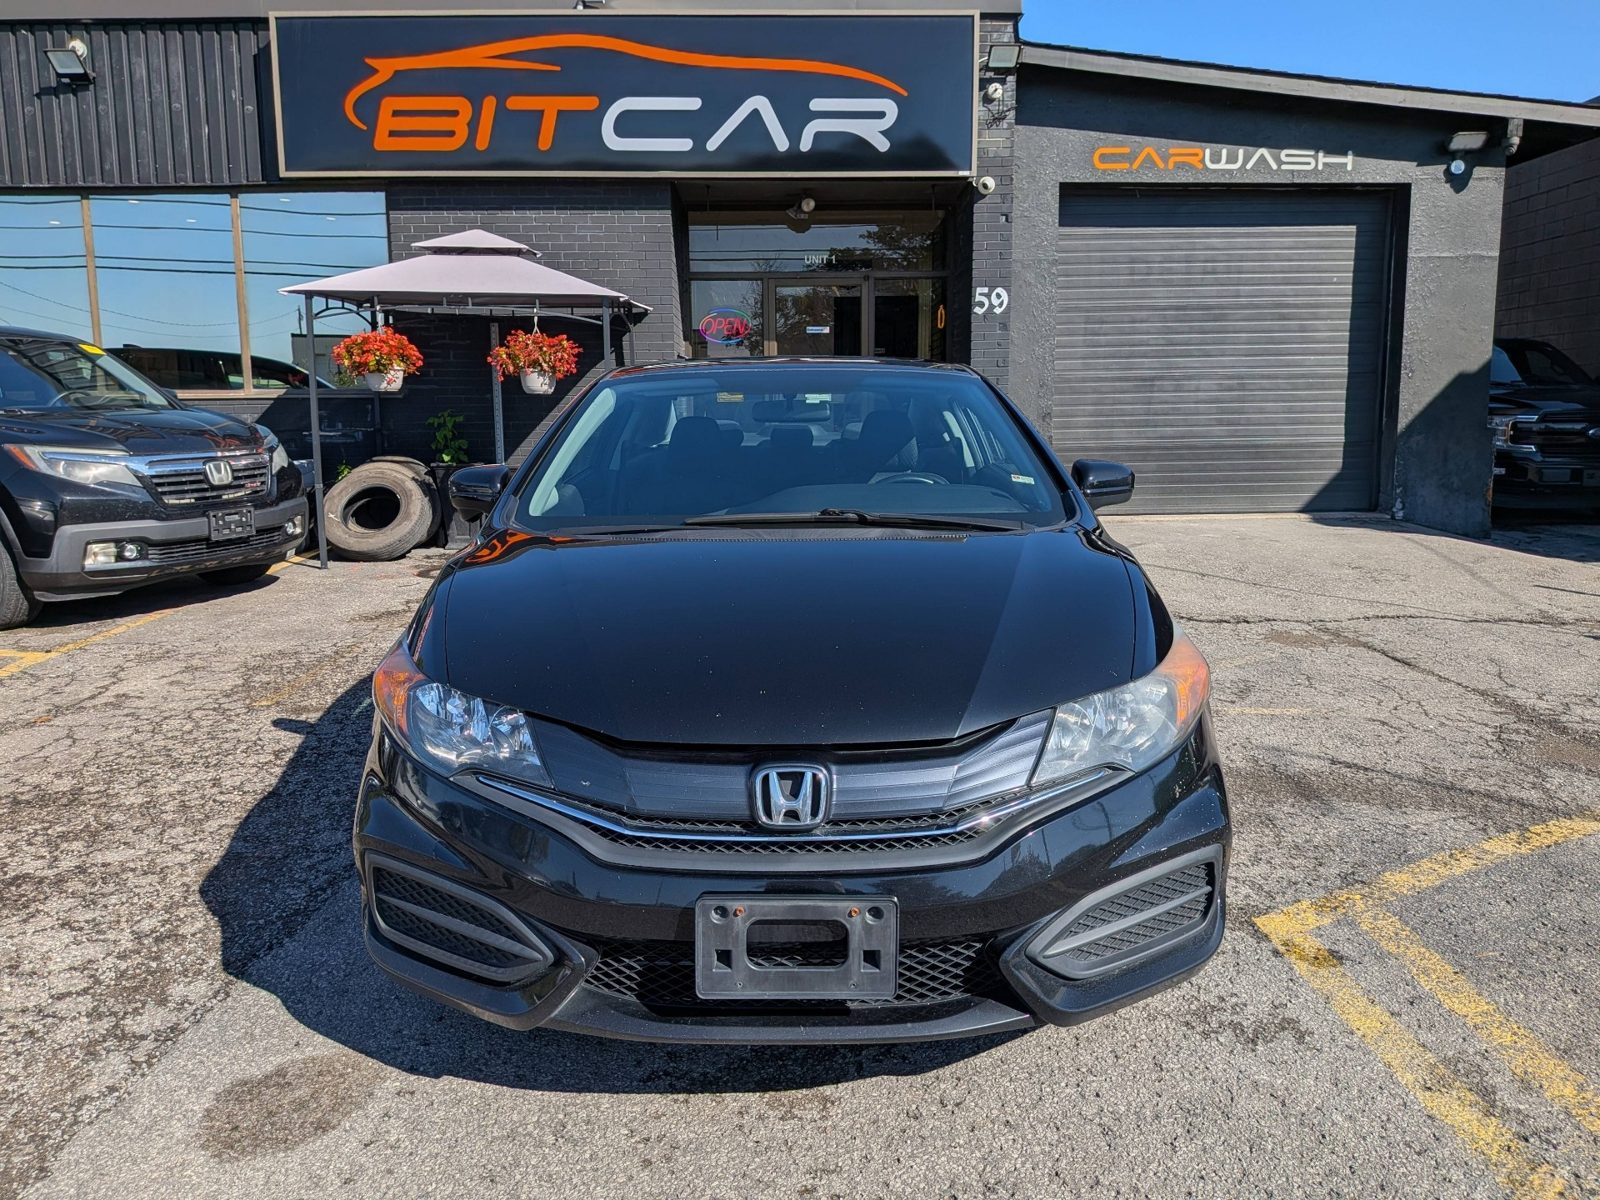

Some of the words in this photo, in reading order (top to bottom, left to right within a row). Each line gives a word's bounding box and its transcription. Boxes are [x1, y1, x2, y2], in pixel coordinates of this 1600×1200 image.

[374, 95, 899, 152] BITCAR
[804, 255, 829, 264] UNIT
[832, 255, 836, 264] 1
[973, 287, 1009, 315] 59
[702, 318, 746, 336] OPEN
